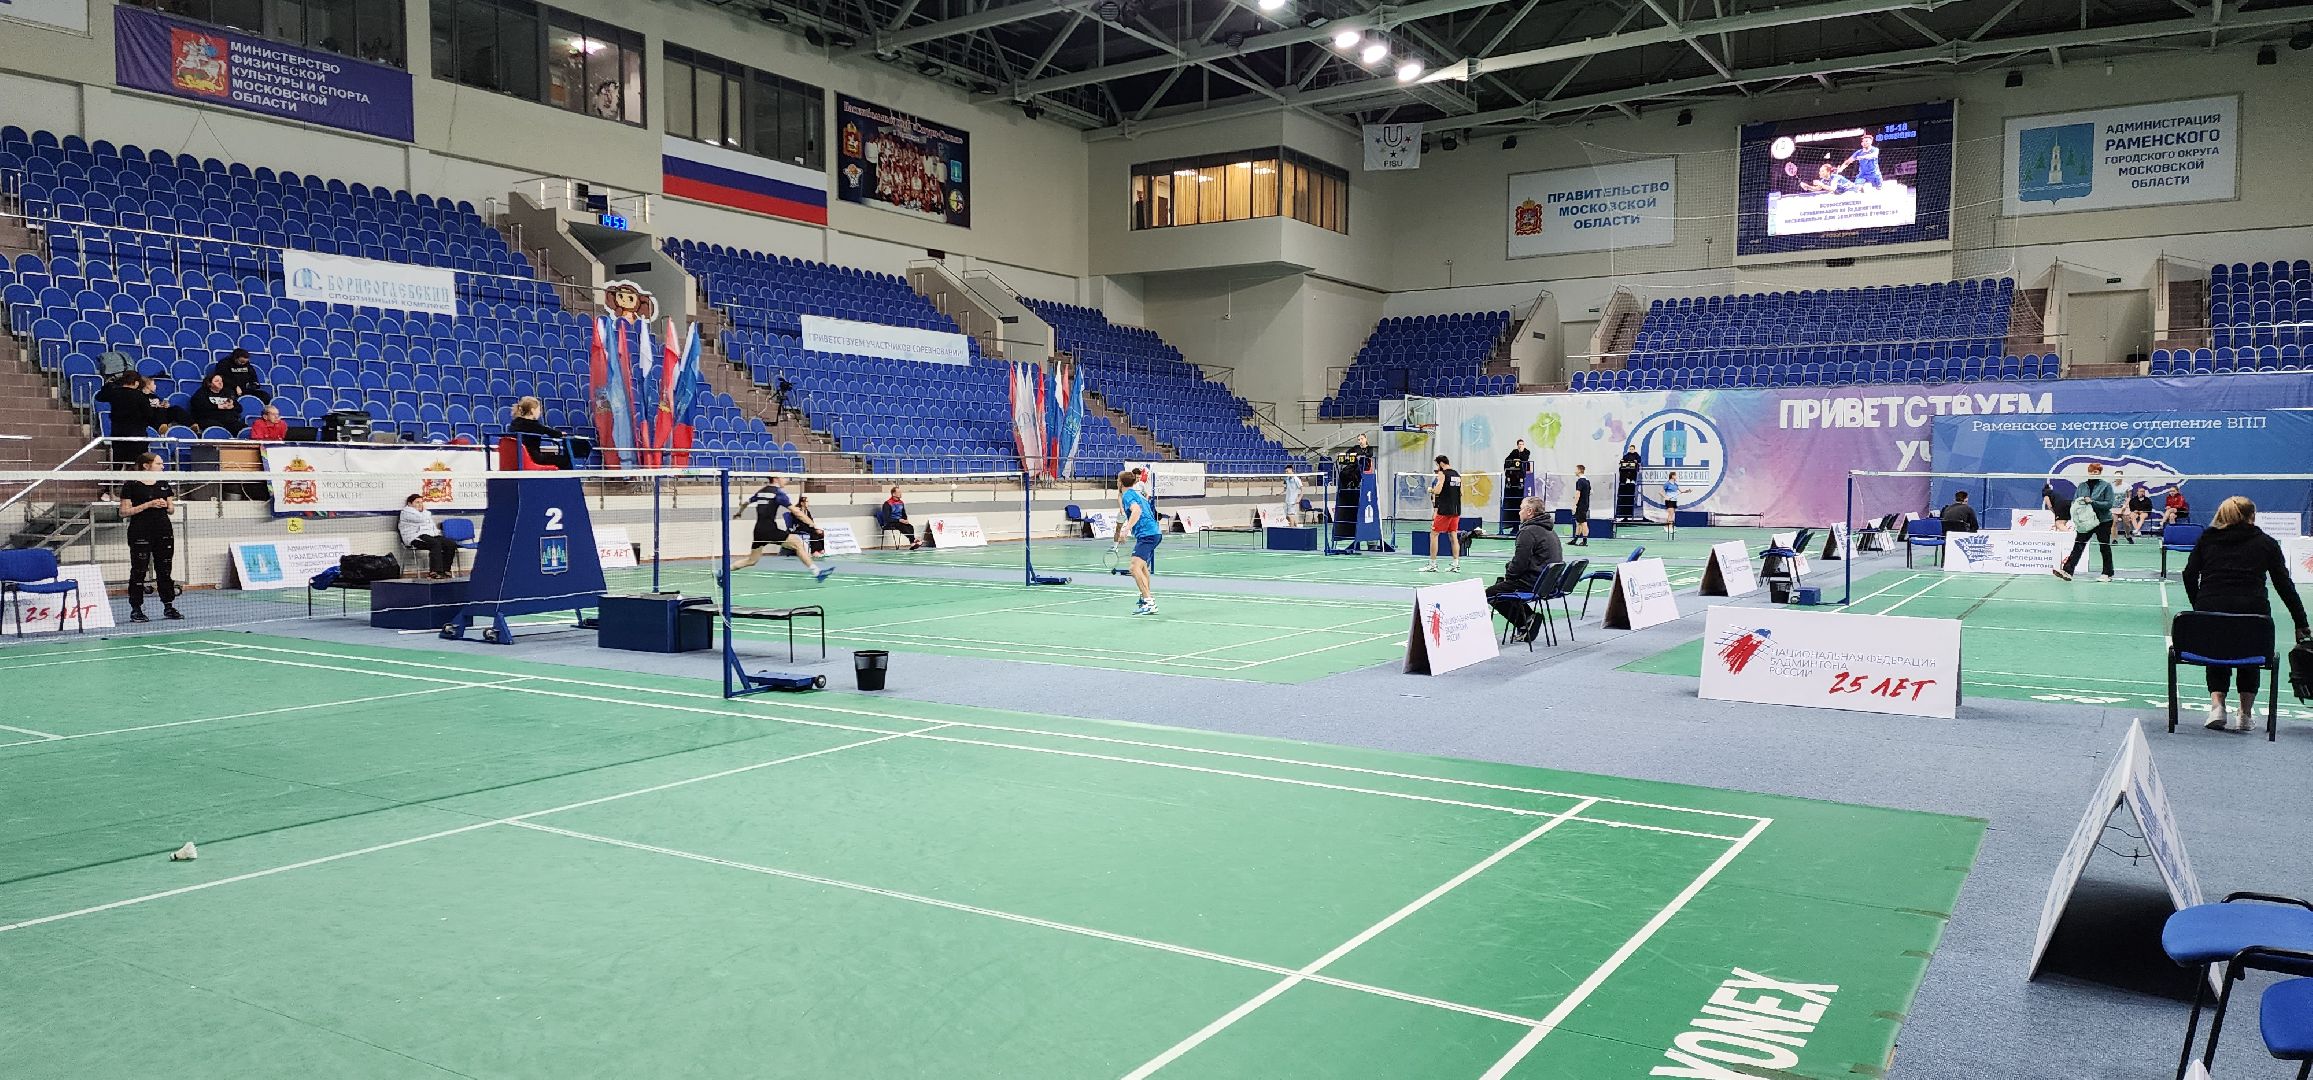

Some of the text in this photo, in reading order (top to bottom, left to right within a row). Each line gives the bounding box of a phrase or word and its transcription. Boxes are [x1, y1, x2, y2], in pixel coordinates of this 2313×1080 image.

[230, 41, 341, 74] МИНИСТЕРСТВО
[231, 53, 327, 82] ФИЗИЧЕСКОЙ
[231, 65, 371, 104] КУЛЬТУРЫ И СПОРТА
[232, 78, 328, 106] МОСКОВСКОЙ
[232, 90, 298, 112] ОБЛАСТИ
[2105, 114, 2220, 134] АДМИНИСТРАЦИЯ
[2105, 129, 2220, 151] РАМЕНСКОГО
[1383, 159, 1403, 168] FISU
[2105, 147, 2220, 165] ГОРОДСКОГО ОКРУГА
[2118, 158, 2205, 176] МОСКОВСКОЙ
[1547, 181, 1670, 204] ПРАВИТЕЛЬСТВО
[2131, 176, 2190, 189] ОБЛАСТИ
[1559, 196, 1657, 217] МОСКОВСКОЙ
[1573, 215, 1641, 230] ОБЛАСТИ
[1780, 393, 2053, 428] ПРИВЕТСТВУЕМ
[1972, 416, 2266, 432] Раменское местное отделение ВПП
[2039, 436, 2196, 451] "ЕДИНАЯ РОССИЯ"
[1366, 490, 1372, 502] 1
[545, 507, 563, 530] 2
[26, 606, 50, 622] 25
[1770, 657, 1848, 671] БАДМИНТОНА
[1771, 648, 1936, 668] НАЦИОНАЛЬНАЯ ФЕДЕРАЦИЯ
[1769, 667, 1813, 678] РОССИИ
[1828, 672, 1938, 702] 25 ЛЕТ
